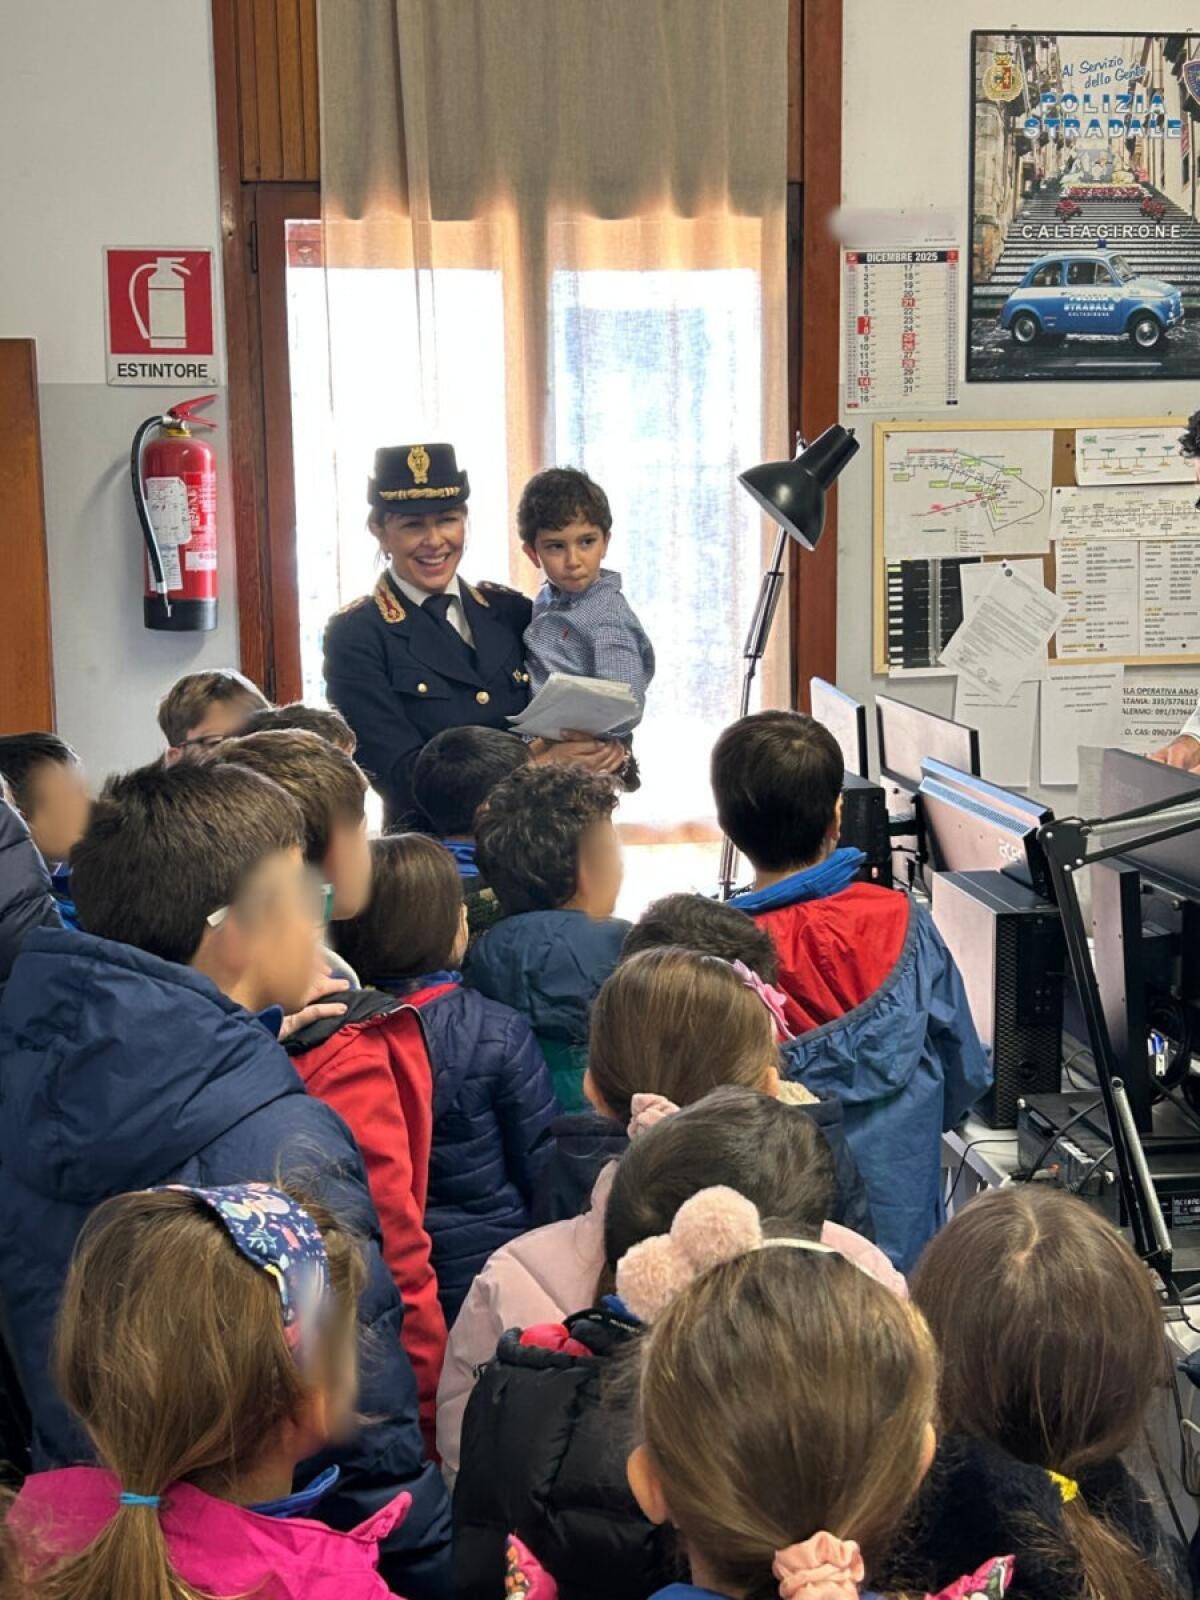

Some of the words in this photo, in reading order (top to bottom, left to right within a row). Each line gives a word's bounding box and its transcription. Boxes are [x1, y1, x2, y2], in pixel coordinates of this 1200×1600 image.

[1062, 64, 1074, 77] Al
[1079, 55, 1124, 74] Servizio
[1115, 66, 1147, 81] Gente
[1040, 93, 1165, 114] POLIZIA
[1024, 117, 1183, 139] STRADALE
[1021, 224, 1181, 239] CALTAGIRONE
[866, 252, 913, 263] DICEMBRE
[915, 251, 938, 262] 2025
[117, 363, 208, 378] ESTINTORE
